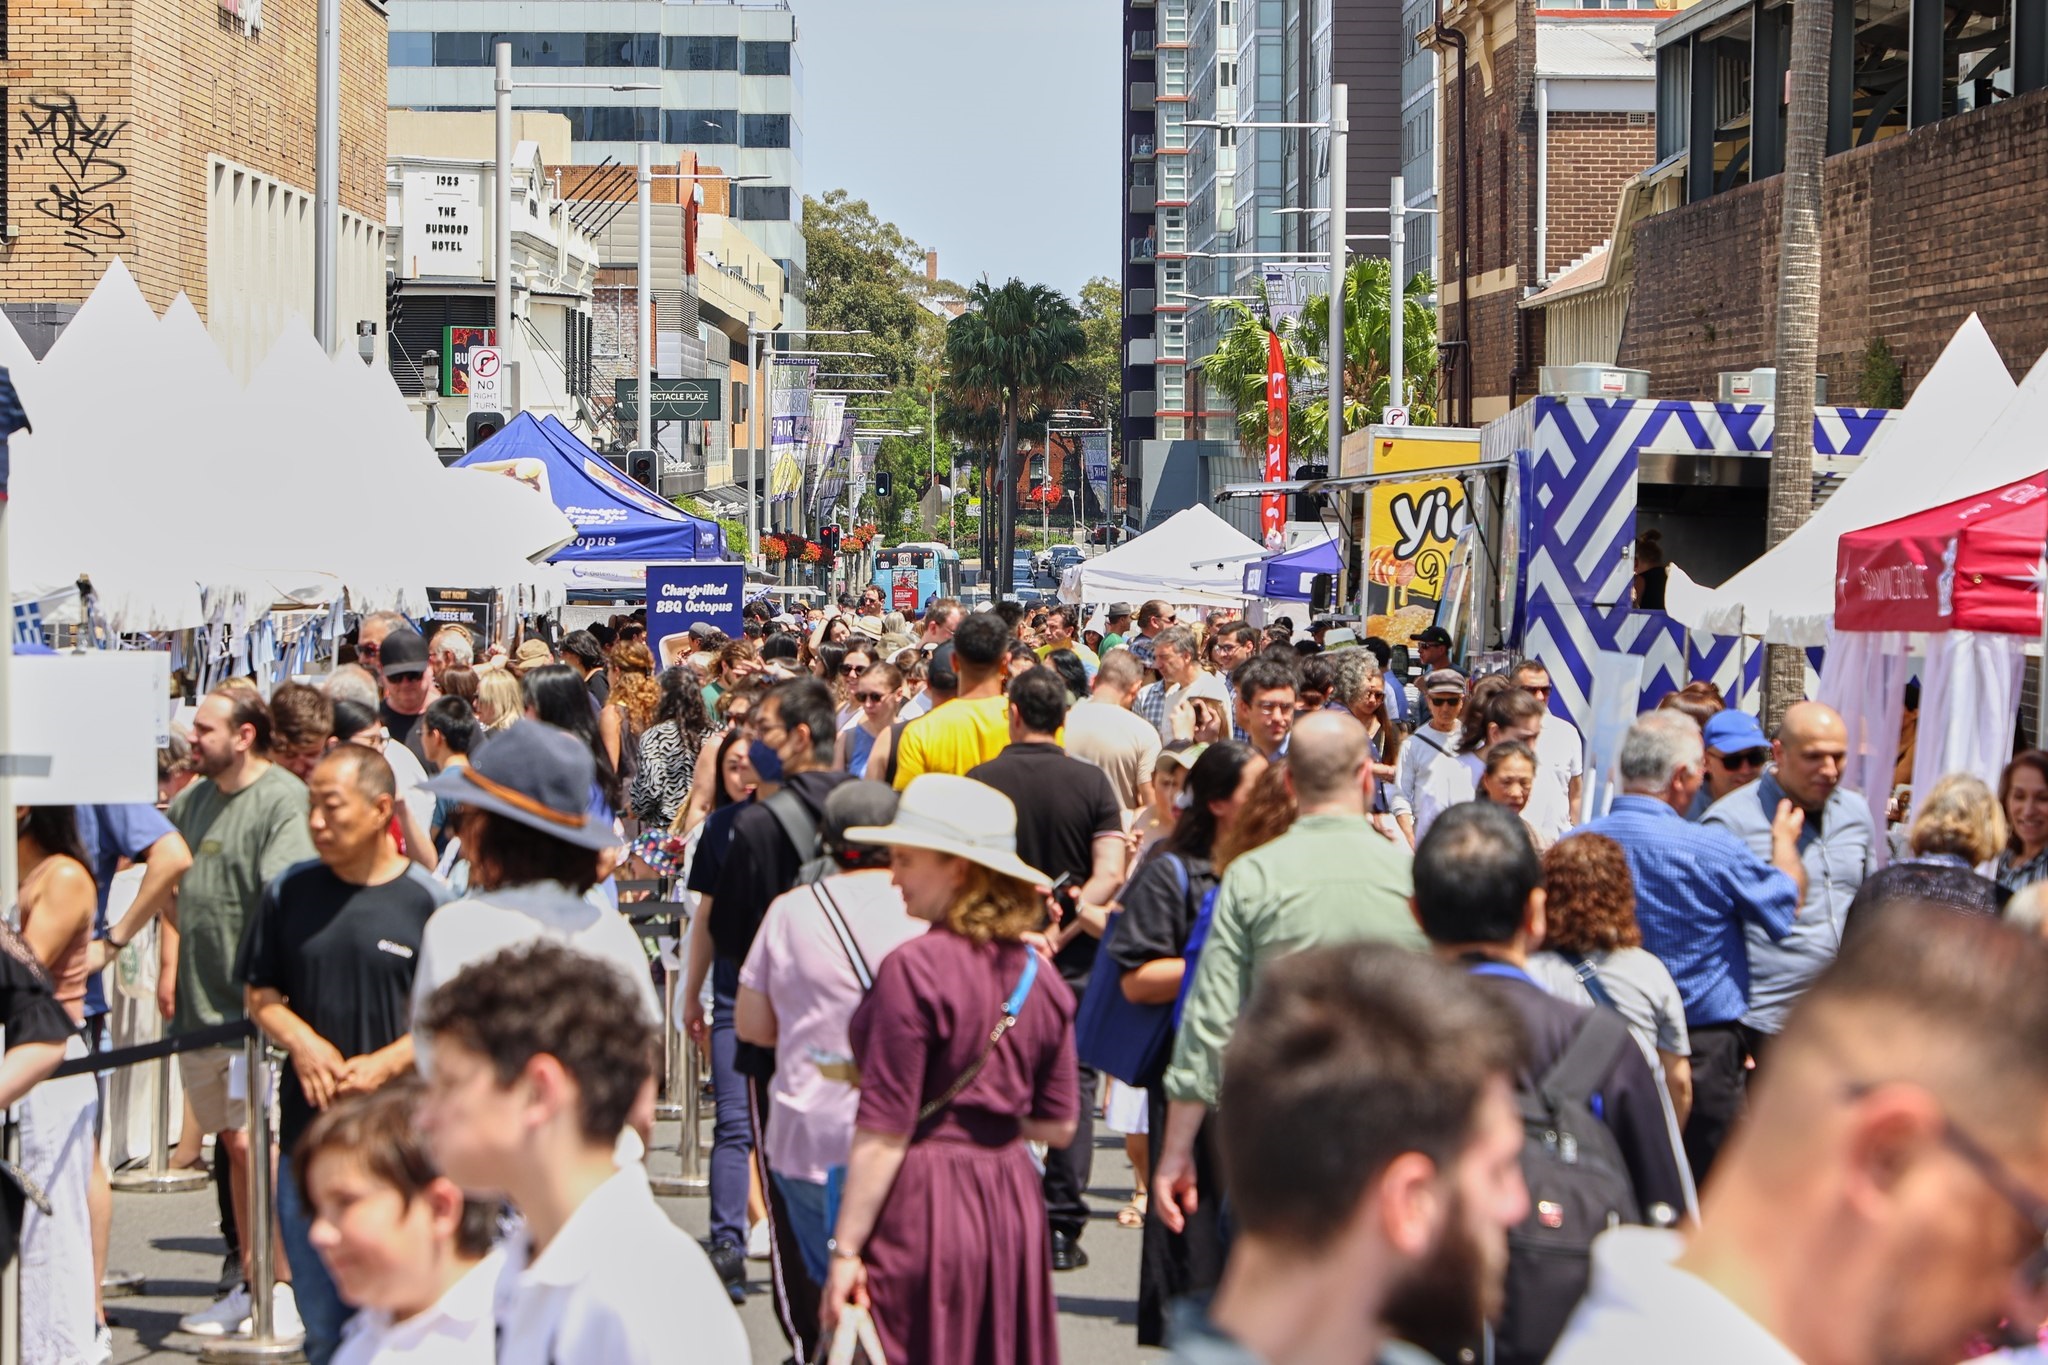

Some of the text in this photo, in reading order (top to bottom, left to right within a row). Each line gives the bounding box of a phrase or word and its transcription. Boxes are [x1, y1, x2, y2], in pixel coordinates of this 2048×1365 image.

[438, 206, 457, 217] THE
[425, 223, 469, 235] BURWOOD
[431, 241, 463, 252] HOTEL
[454, 352, 470, 365] BU
[477, 380, 495, 390] NO
[473, 392, 497, 400] RIGHT
[650, 392, 684, 401] PECTACLE
[685, 392, 709, 401] PLACE
[772, 419, 794, 437] FAIR
[661, 583, 729, 600] Chargrilled
[655, 600, 733, 616] BBQ Octopus
